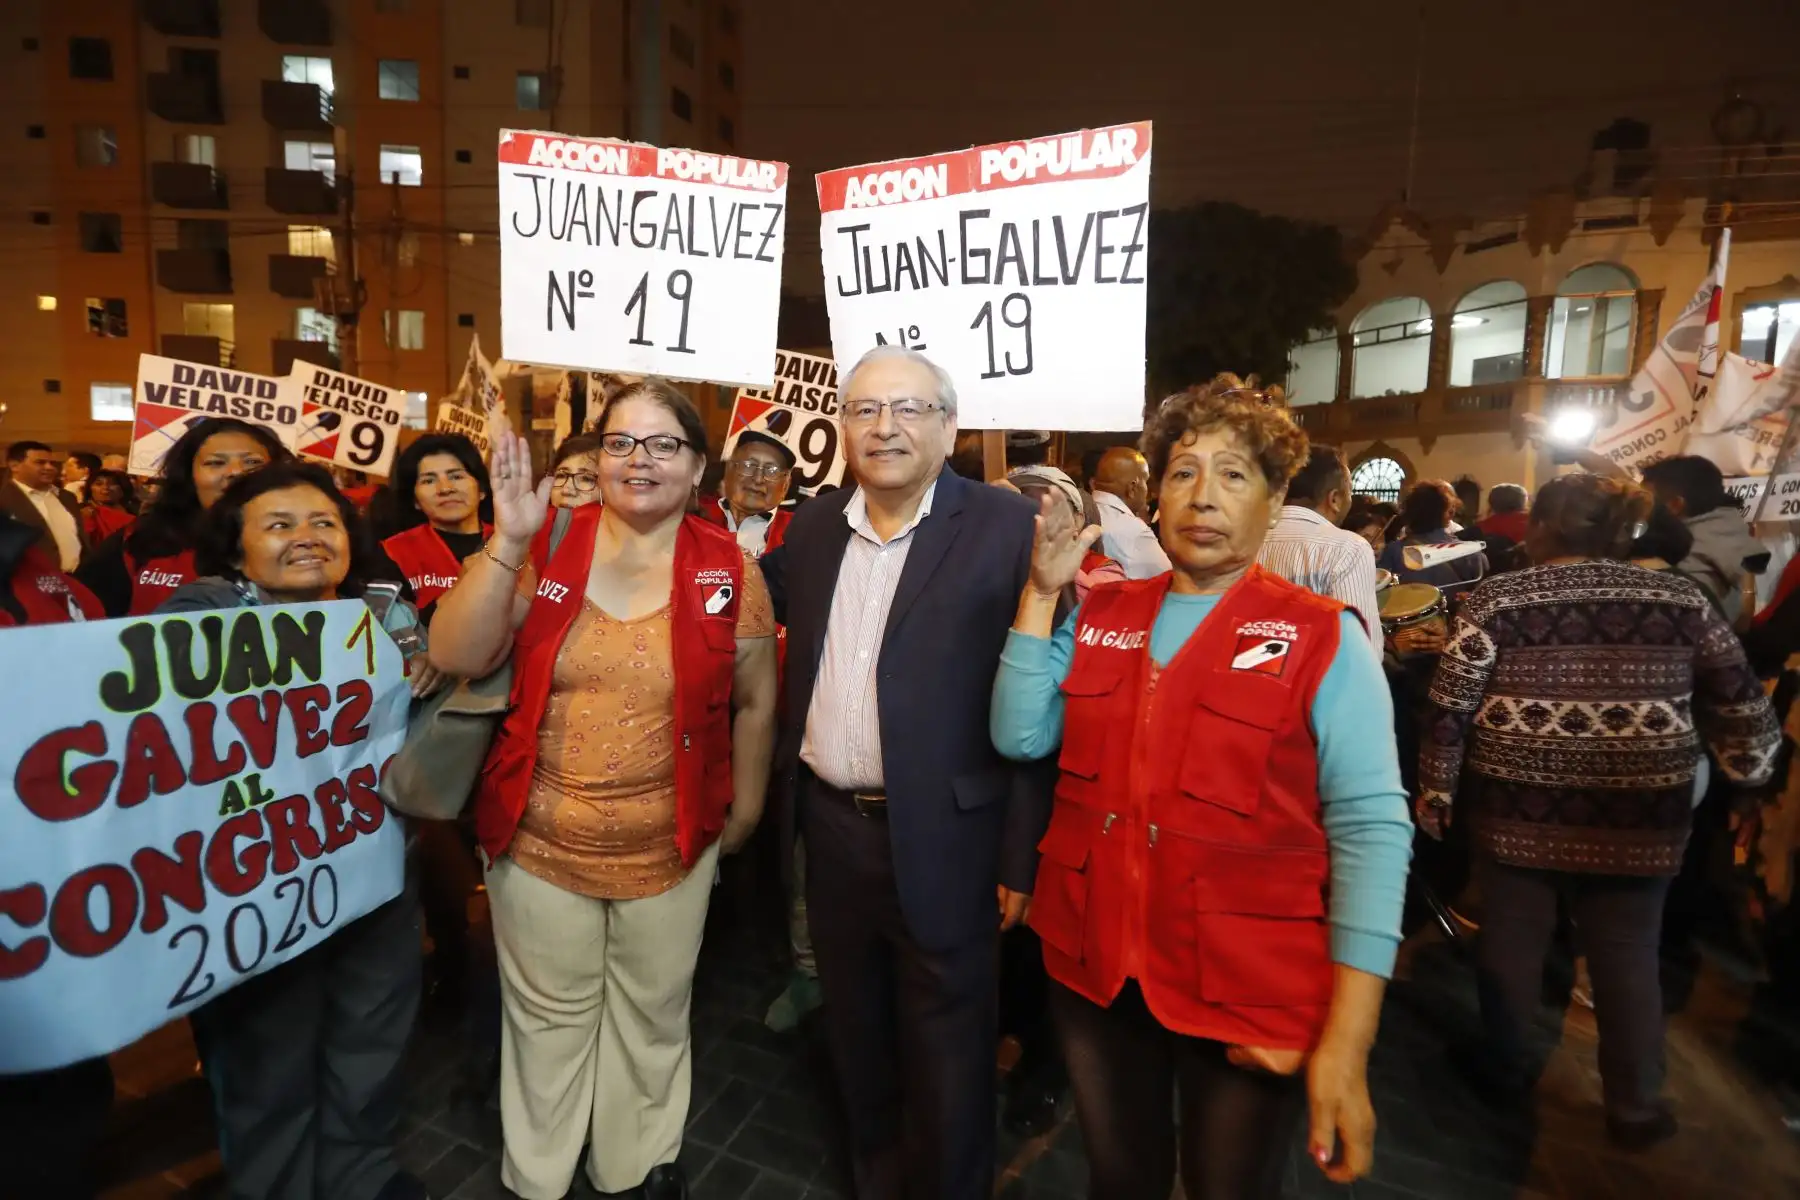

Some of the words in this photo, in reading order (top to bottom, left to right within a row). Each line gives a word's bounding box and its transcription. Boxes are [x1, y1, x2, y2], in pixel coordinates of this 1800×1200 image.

[528, 138, 629, 175] ACCION
[657, 148, 777, 189] POPULAR
[843, 164, 948, 209] ACCION
[980, 128, 1139, 184] POPULAR
[512, 172, 784, 263] JUAN-GALVEZ
[837, 202, 1148, 297] JUAN-GALVEZ
[624, 269, 696, 354] 19
[970, 292, 1034, 380] 19
[144, 381, 297, 425] VELASCO
[172, 363, 277, 400] DAVID
[313, 370, 388, 404] DAVID
[449, 407, 484, 433] DAVID
[347, 421, 385, 466] 9
[791, 418, 837, 488] 9
[139, 568, 183, 588] GÁLVEZ
[424, 573, 458, 589] GÁLVE
[536, 578, 570, 603] LVEZ
[697, 569, 729, 577] ACCIÓN
[1235, 627, 1299, 642] POPULAR
[1243, 620, 1298, 632] ACCIÓN
[99, 610, 326, 714] JUAN
[218, 772, 275, 816] AL
[0, 754, 400, 981] CONGRES
[167, 864, 338, 1010] 2020
